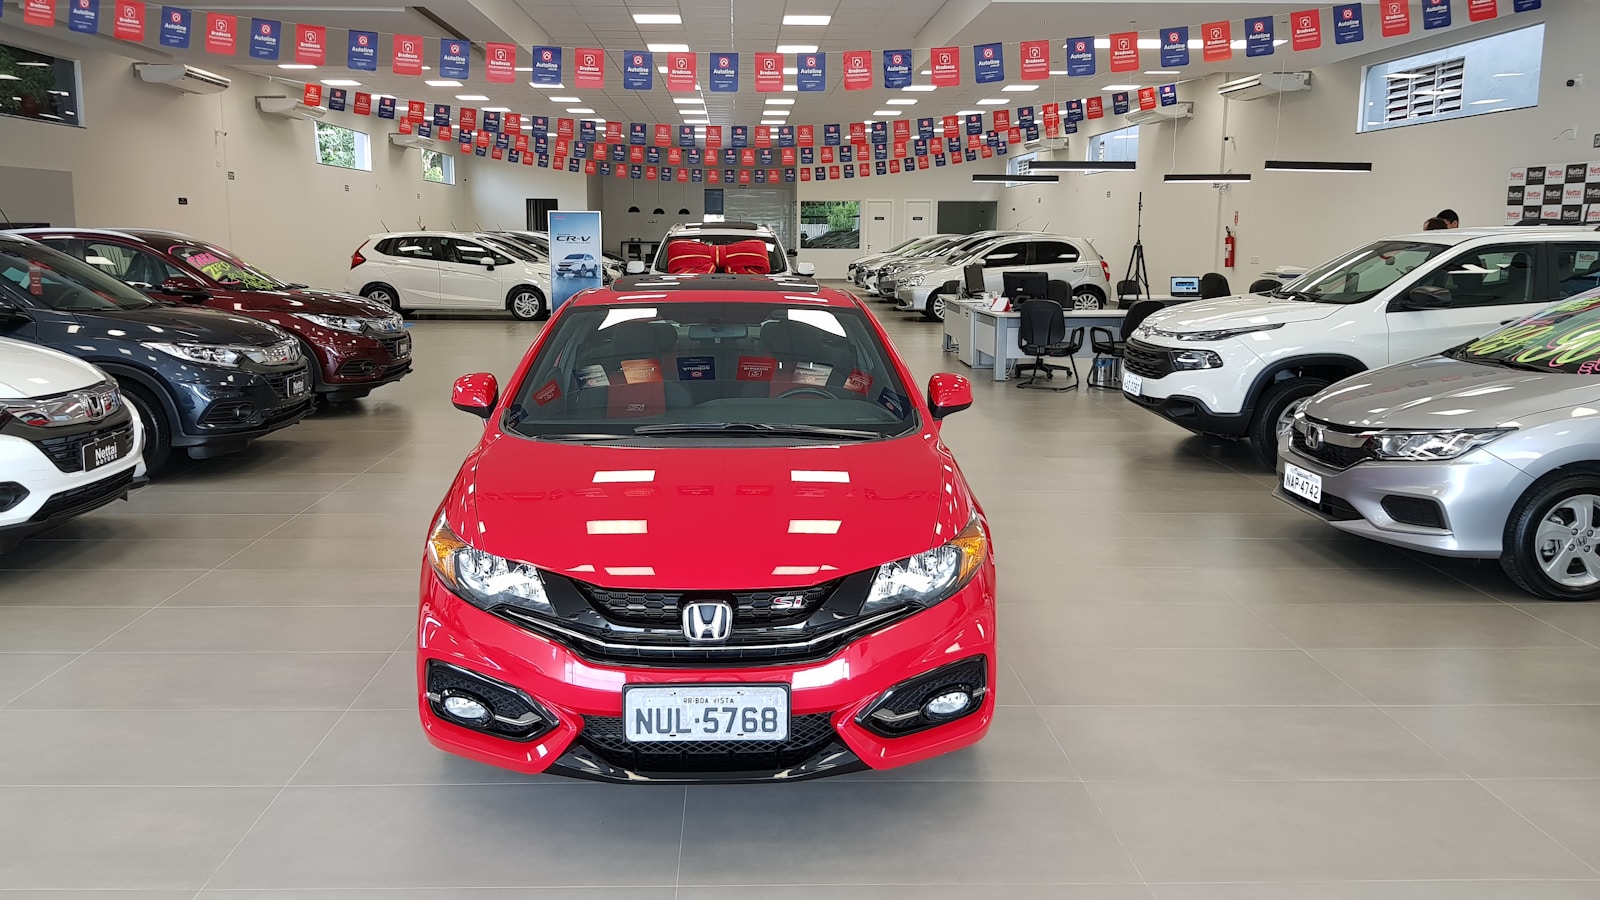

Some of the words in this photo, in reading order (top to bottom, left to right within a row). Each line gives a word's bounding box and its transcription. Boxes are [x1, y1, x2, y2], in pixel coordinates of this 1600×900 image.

[165, 23, 187, 31] Autoline
[95, 442, 117, 460] Nettai
[771, 595, 806, 609] Si
